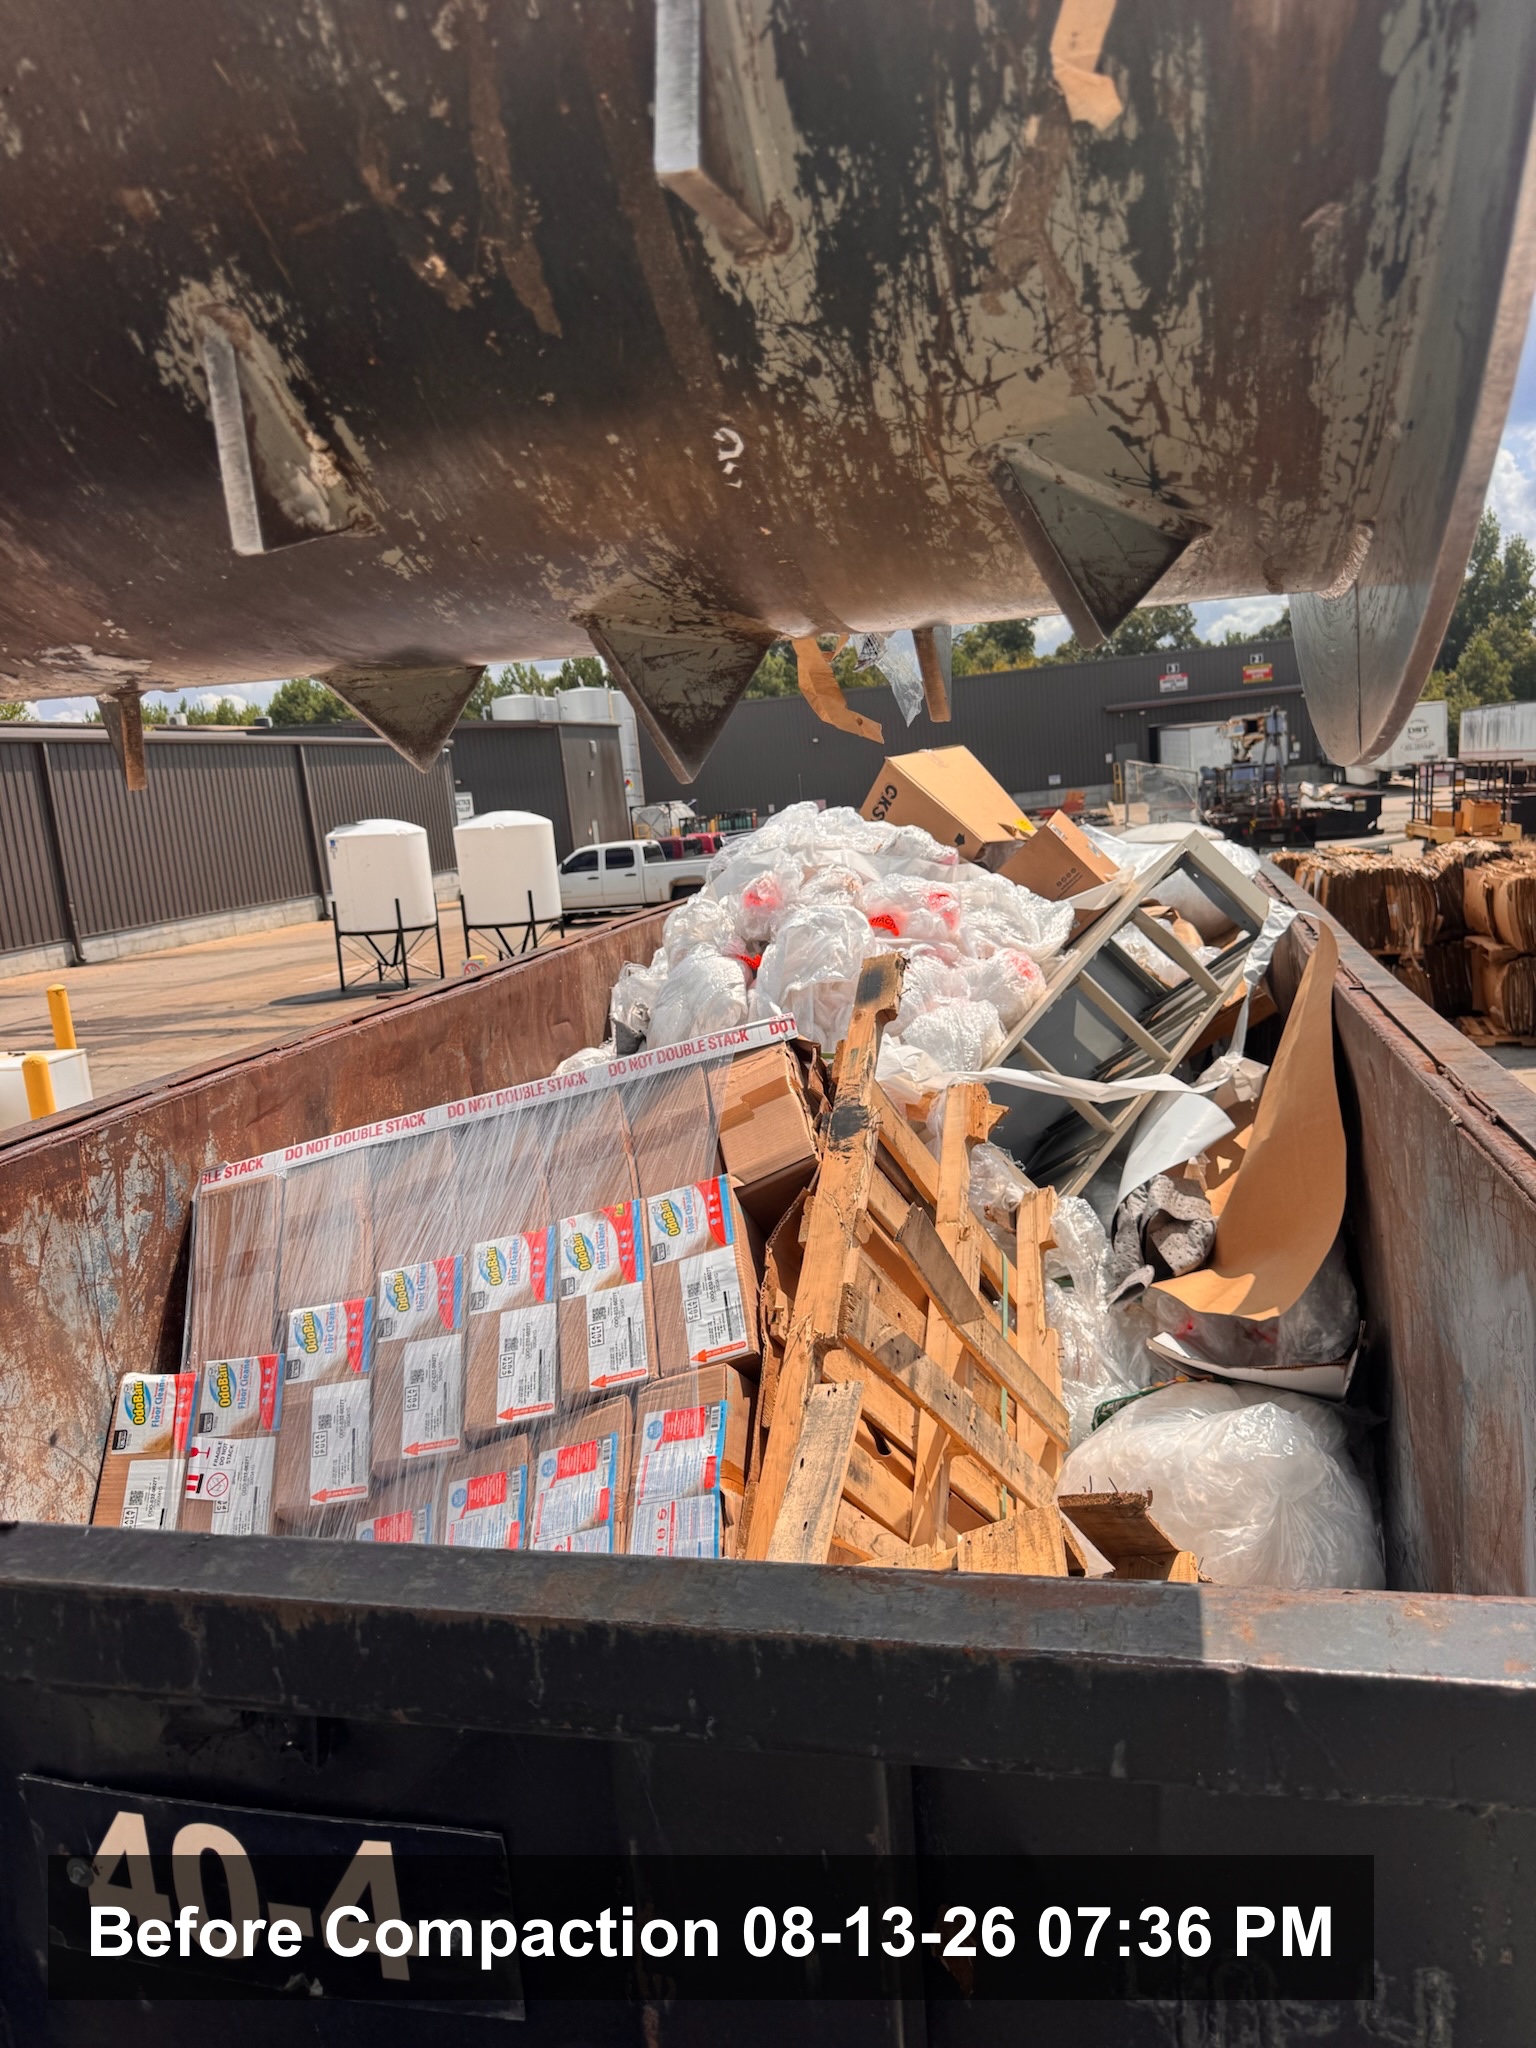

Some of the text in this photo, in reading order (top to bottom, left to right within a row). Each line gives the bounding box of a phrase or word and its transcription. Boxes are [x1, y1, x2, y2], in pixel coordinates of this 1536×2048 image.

[769, 1019, 788, 1035] DO
[609, 1029, 749, 1077] DO NOT DOUBLE STACK
[447, 1071, 588, 1119] DO NOT DOUBLE STACK
[284, 1112, 426, 1162] DO NOT DOUBLE STACK
[224, 1157, 264, 1180] STACK
[661, 1200, 680, 1236] OdoBan
[685, 1189, 695, 1234] Floor Cleaner
[487, 1247, 502, 1285] OdoBan
[509, 1239, 518, 1285] Floor Cleaner
[573, 1233, 591, 1270] OdoBan
[394, 1272, 409, 1311] OdoBan
[416, 1293, 424, 1311] Floor
[303, 1312, 318, 1353] OdoBan
[325, 1335, 334, 1353] Floor
[131, 1381, 145, 1424] OdoBan
[217, 1363, 231, 1407] OdoBan
[237, 1388, 247, 1408] Floor
[151, 1407, 161, 1427] Floor
[213, 1441, 222, 1467] FRAGILE
[219, 1456, 225, 1466] DO
[226, 1444, 234, 1464] STACK
[87, 1811, 418, 1981] 40-4
